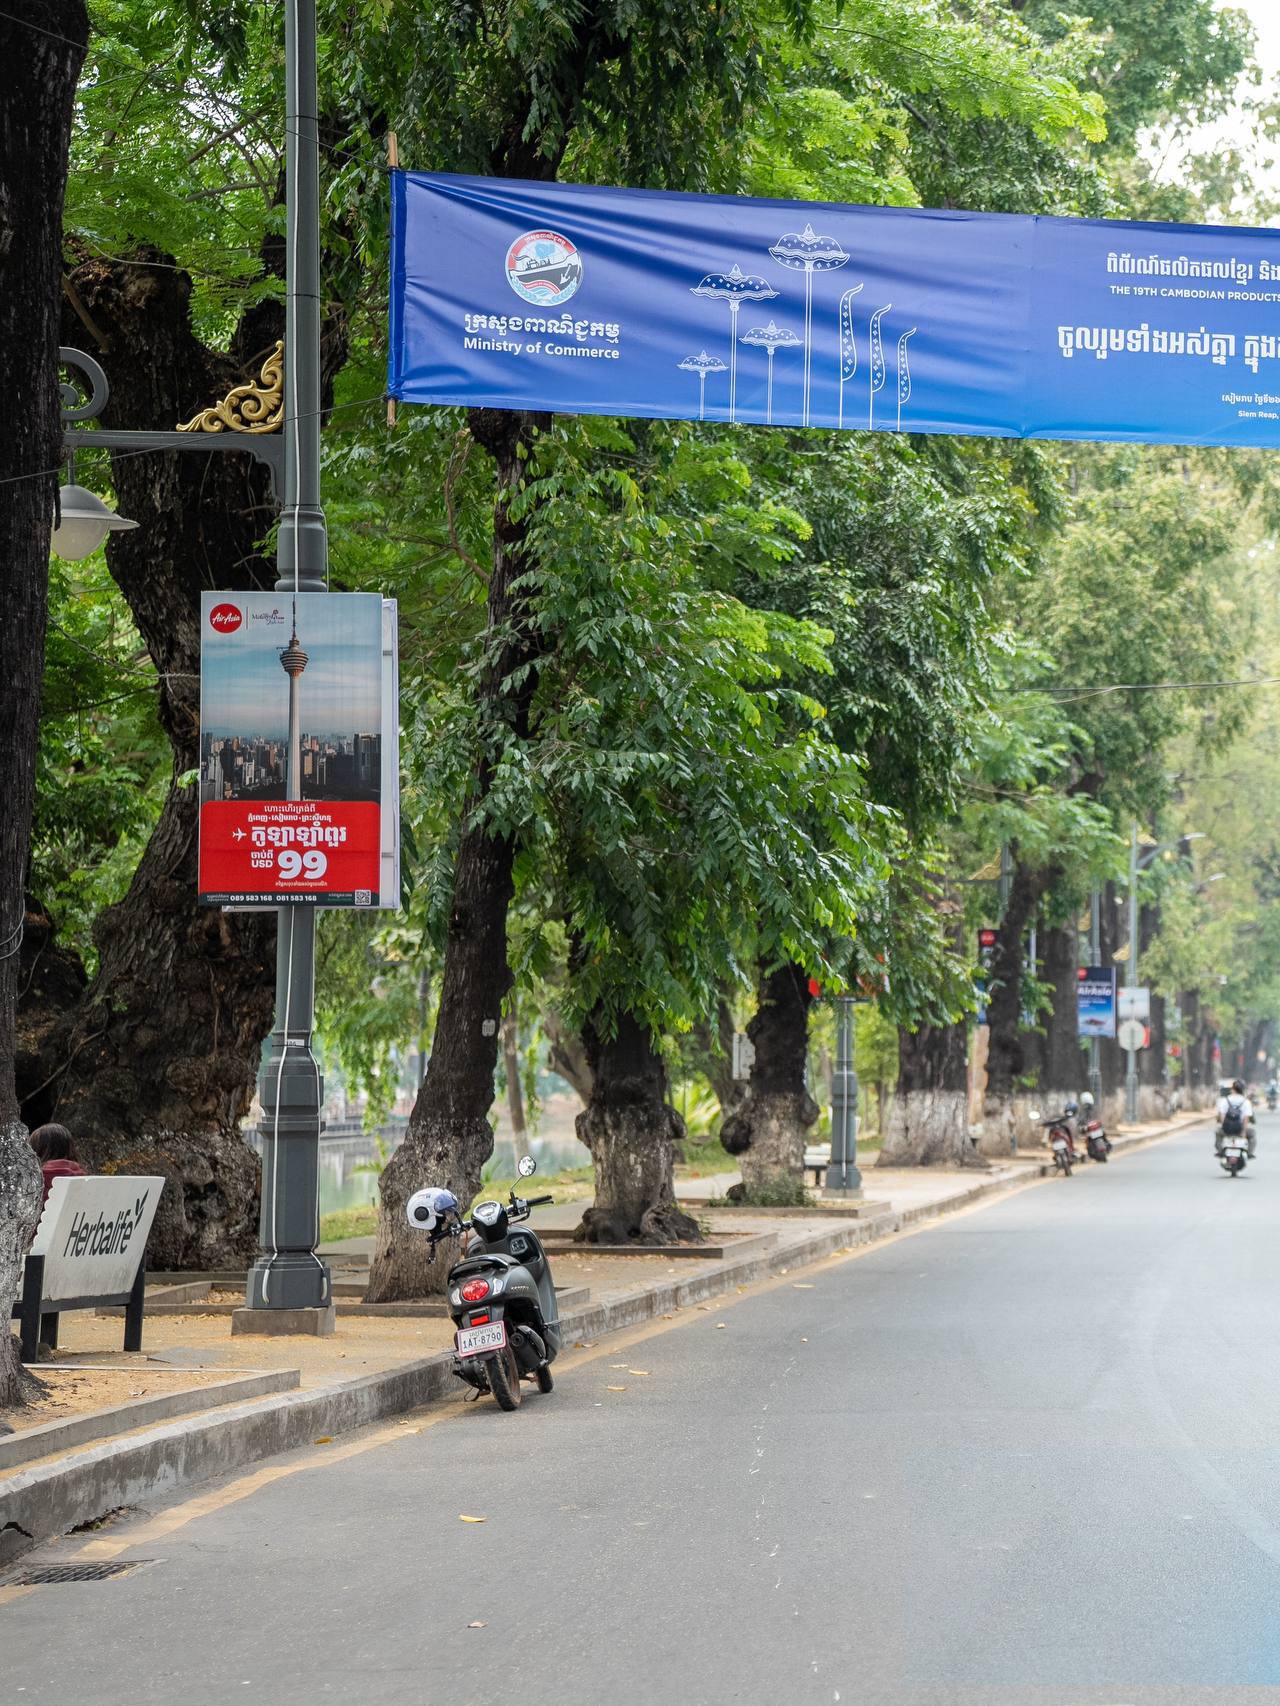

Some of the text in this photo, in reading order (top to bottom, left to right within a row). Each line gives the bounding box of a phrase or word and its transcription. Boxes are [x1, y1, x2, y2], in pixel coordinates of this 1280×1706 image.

[1107, 252, 1253, 286] ពិព័រណ៍ផលិតផលខ្មែរ
[1110, 285, 1130, 295] THE
[1133, 286, 1158, 296] 19TH
[1160, 288, 1225, 300] CAMBODIAN
[464, 313, 620, 344] ក្រសួងពាណិជ្ជកម្ម
[463, 337, 620, 359] Ministry of Commerce
[1057, 323, 1236, 365] ចូលរួមទាំងអស់គ្នា
[1238, 410, 1256, 418] Siem
[1258, 411, 1279, 419] Reap,
[212, 612, 240, 625] AirAsia
[250, 849, 274, 859] ចាប់ពី
[251, 859, 274, 868] USD
[277, 849, 328, 880] 99
[63, 1209, 133, 1257] Herbalife
